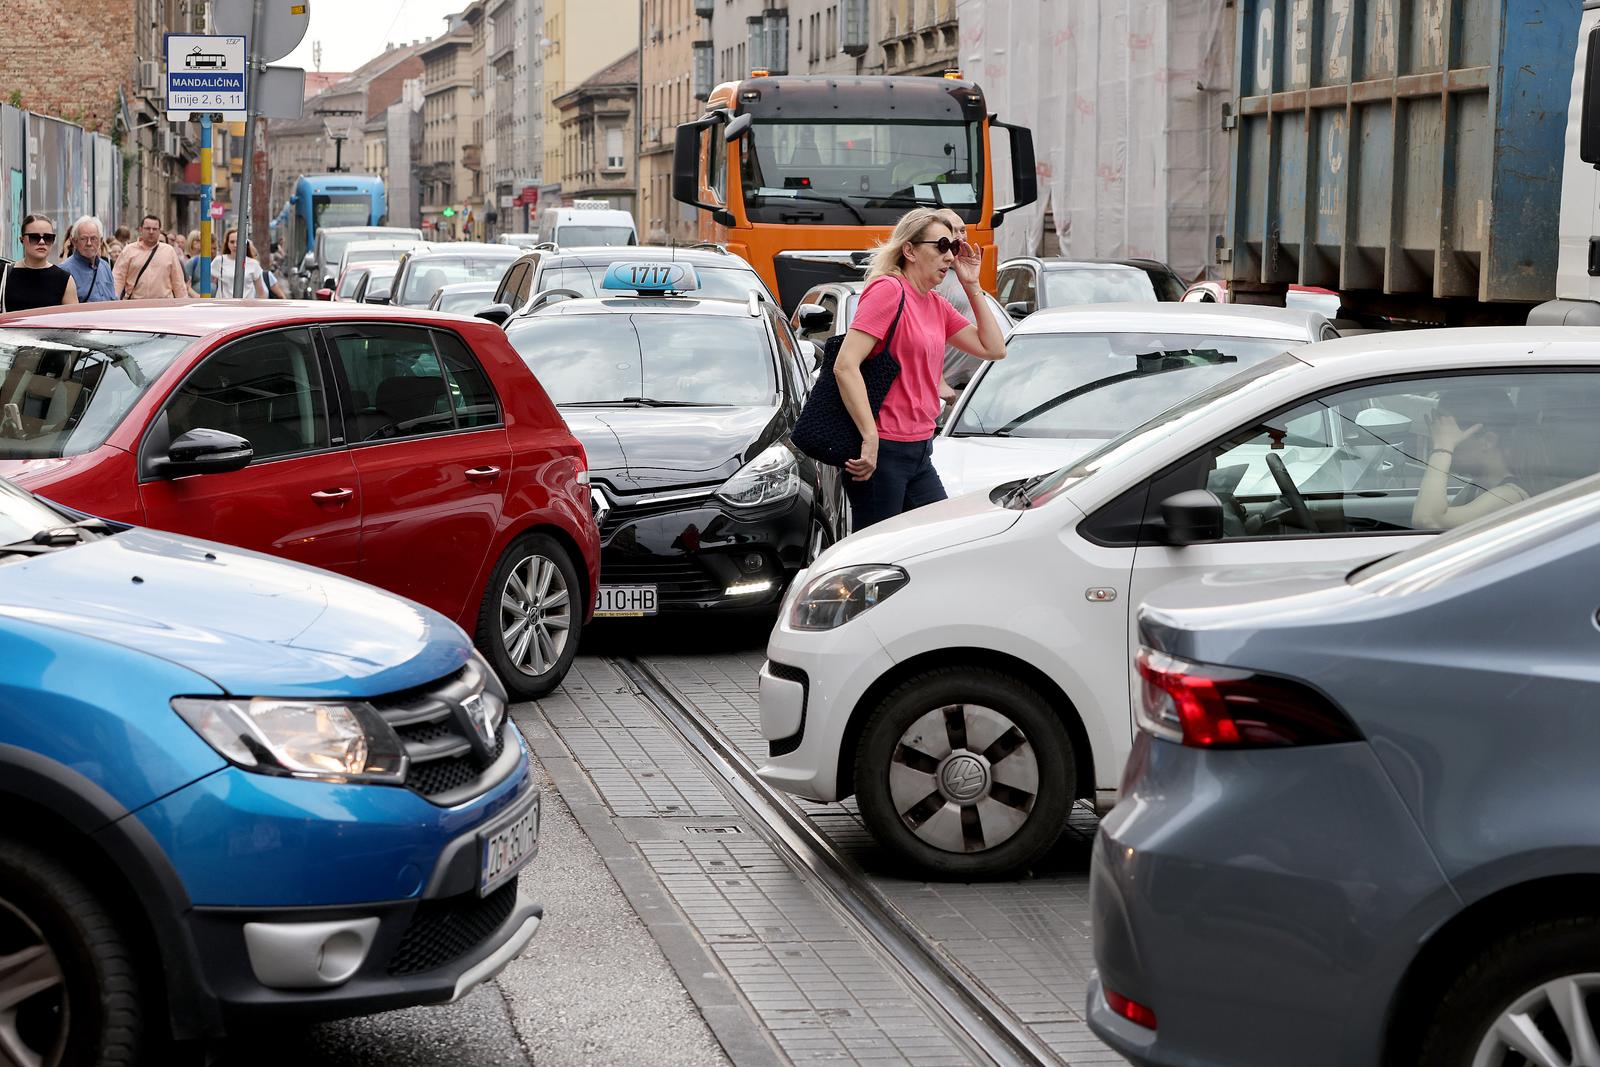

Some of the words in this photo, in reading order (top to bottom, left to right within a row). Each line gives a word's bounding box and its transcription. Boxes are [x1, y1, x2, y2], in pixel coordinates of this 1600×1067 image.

[1257, 0, 1445, 90] CEZAR
[172, 77, 240, 88] MANDALIČINA
[174, 94, 199, 106] linije
[202, 95, 212, 105] 2,
[215, 95, 225, 105] 6,
[230, 95, 240, 104] 11
[630, 266, 672, 284] 1717
